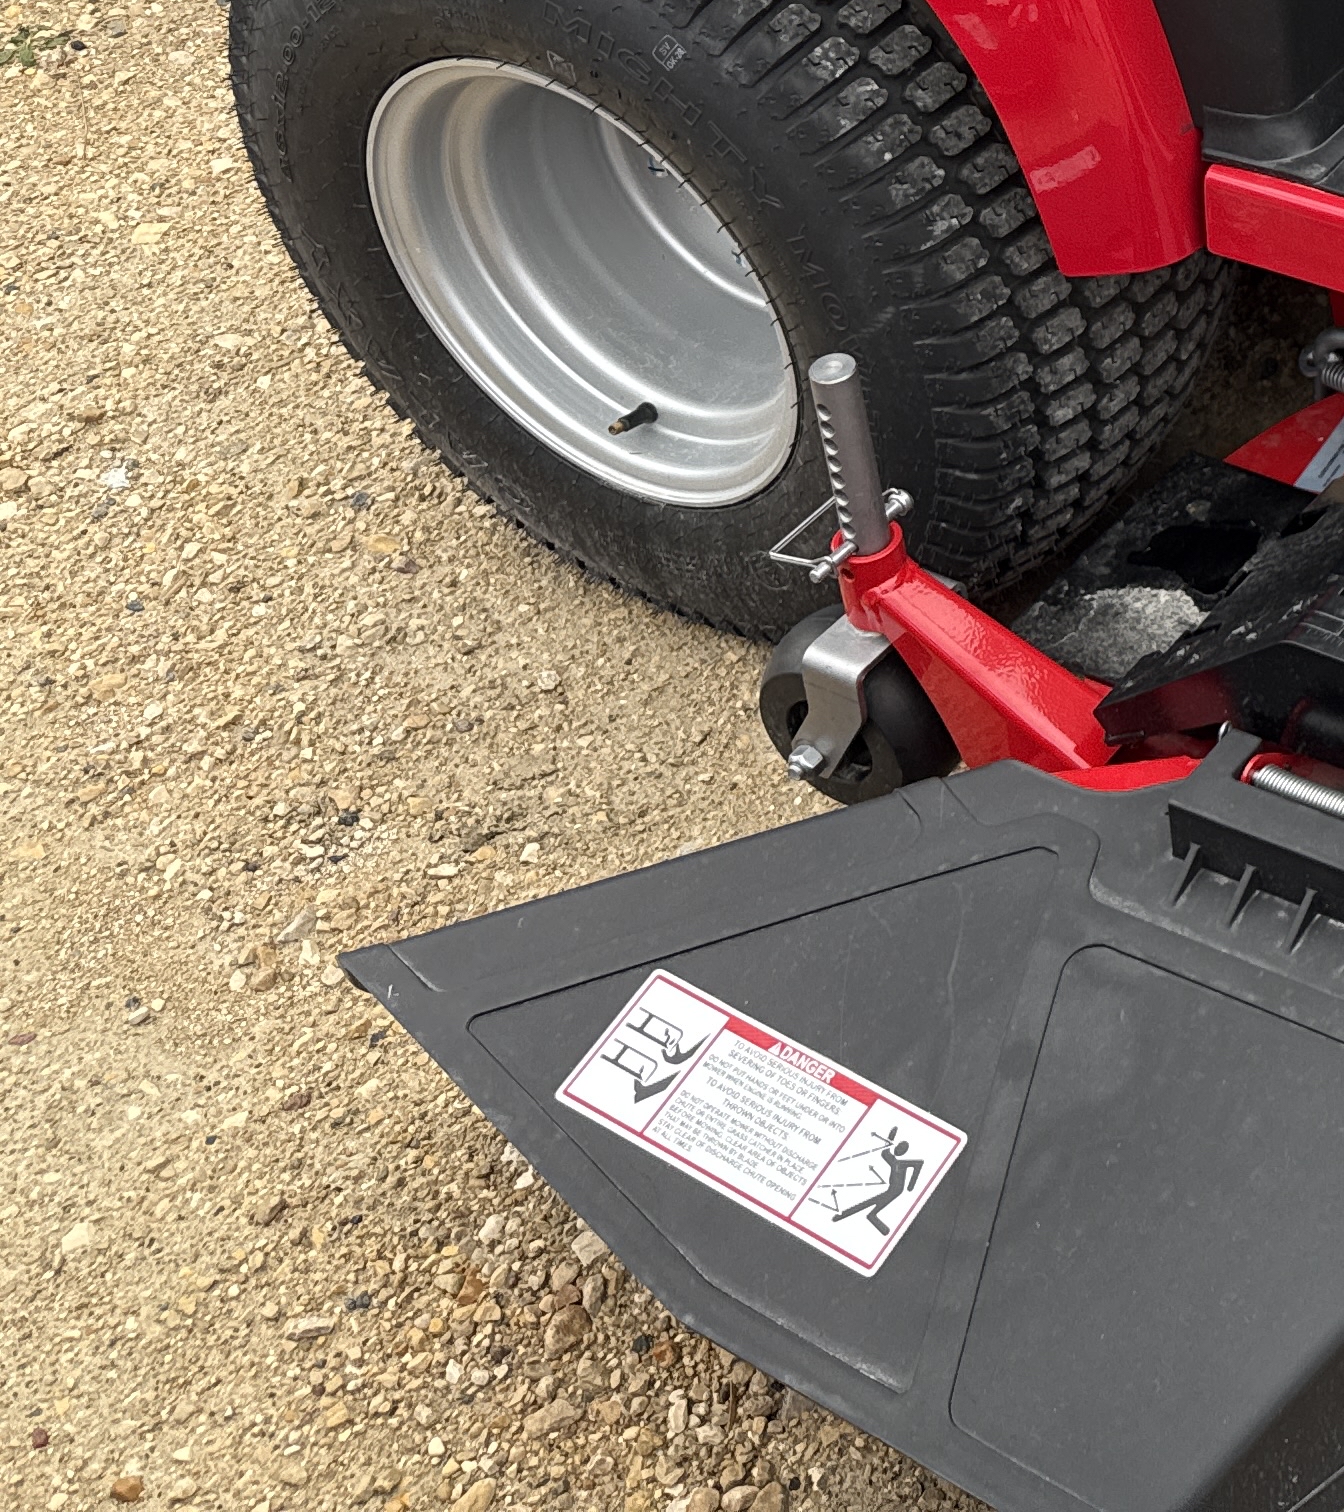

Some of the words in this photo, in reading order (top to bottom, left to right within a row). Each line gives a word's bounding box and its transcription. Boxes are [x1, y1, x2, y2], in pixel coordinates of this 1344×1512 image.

[701, 1059, 727, 1077] MOWER
[724, 1072, 745, 1088] WHEN
[742, 1082, 768, 1100] ENGINE
[765, 1095, 775, 1104] IS
[707, 1052, 721, 1064] DO
[717, 1058, 733, 1071] NOT
[730, 1065, 747, 1078] PUT
[743, 1073, 770, 1091] HANDS
[766, 1085, 780, 1097] OR
[776, 1091, 796, 1106] FEET
[793, 1100, 819, 1119] UNDER
[816, 1113, 830, 1125] OR
[827, 1119, 846, 1134] INTO
[727, 1048, 767, 1074] SEVERING
[763, 1068, 777, 1080] OF
[774, 1074, 797, 1091] TOES
[794, 1085, 809, 1098] OR
[732, 1038, 746, 1050] TO
[743, 1044, 768, 1062] AVOID
[765, 1057, 800, 1080] SERIOUS
[797, 1074, 827, 1095] INJURY
[824, 1089, 849, 1107] FROM
[778, 1045, 837, 1084] DANGER
[650, 1124, 661, 1134] AT
[659, 1129, 674, 1141] ALL
[662, 1109, 680, 1124] THAT
[678, 1118, 694, 1131] MAY
[691, 1126, 702, 1136] BE
[700, 1131, 730, 1152] THROWN
[727, 1147, 738, 1157] BY
[673, 1095, 697, 1113] CHUTE
[694, 1107, 706, 1118] OR
[703, 1112, 728, 1130] ENTIRE
[725, 1124, 749, 1142] GRASS
[746, 1136, 778, 1159] CATCHER
[774, 1152, 785, 1163] IN
[679, 1088, 692, 1099] DO
[688, 1093, 704, 1107] NOT
[701, 1101, 731, 1122] OPERATE
[728, 1116, 755, 1135] MOWER
[751, 1129, 783, 1151] WITHOUT
[780, 1145, 819, 1171] DISCHARGE
[704, 1075, 719, 1087] TO
[715, 1081, 742, 1100] AVOID
[738, 1094, 774, 1118] SERIOUS
[770, 1112, 800, 1133] INJURY
[796, 1127, 822, 1145] FROM
[720, 1097, 756, 1121] THROWN
[656, 1116, 676, 1132] STAY
[672, 1125, 697, 1144] CLEAR
[694, 1138, 707, 1150] OF
[703, 1143, 744, 1171] DISCHARGE
[741, 1165, 767, 1184] CHUTE
[763, 1178, 797, 1202] OPENING
[668, 1102, 696, 1123] BEFORE
[723, 1134, 749, 1153] CLEAR
[745, 1147, 767, 1163] AREA
[763, 1157, 777, 1169] OF
[774, 1163, 808, 1187] OBJECTS
